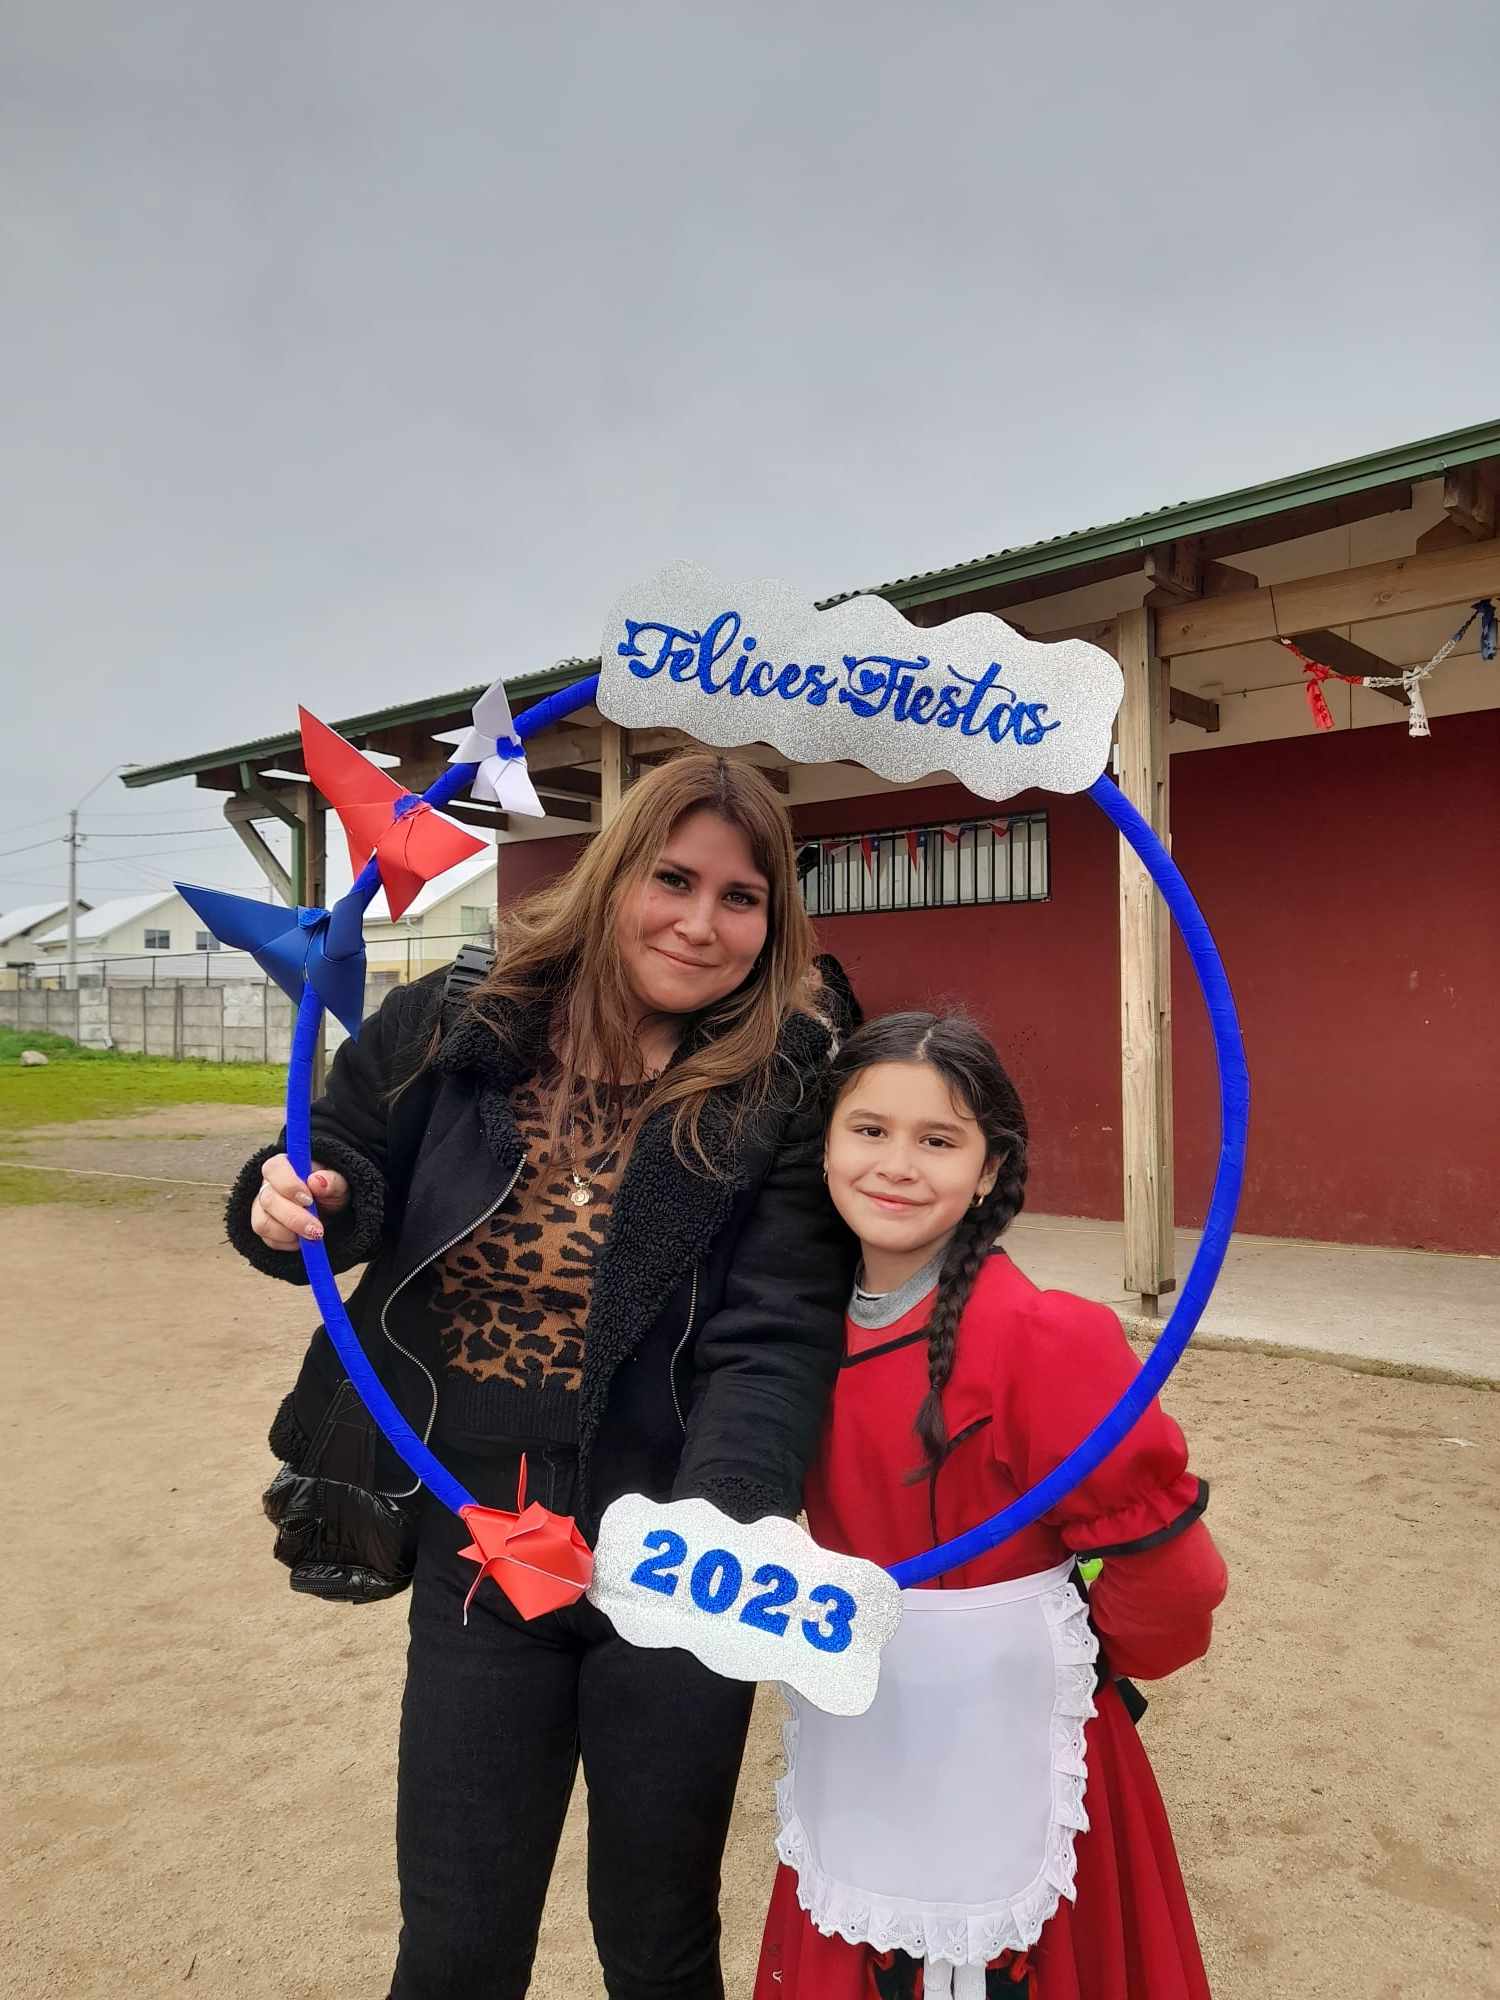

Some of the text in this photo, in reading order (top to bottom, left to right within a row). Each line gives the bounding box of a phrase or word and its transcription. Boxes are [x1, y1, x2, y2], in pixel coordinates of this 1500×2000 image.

[617, 611, 1061, 745] Felices Fiestas
[630, 1529, 857, 1653] 2023
